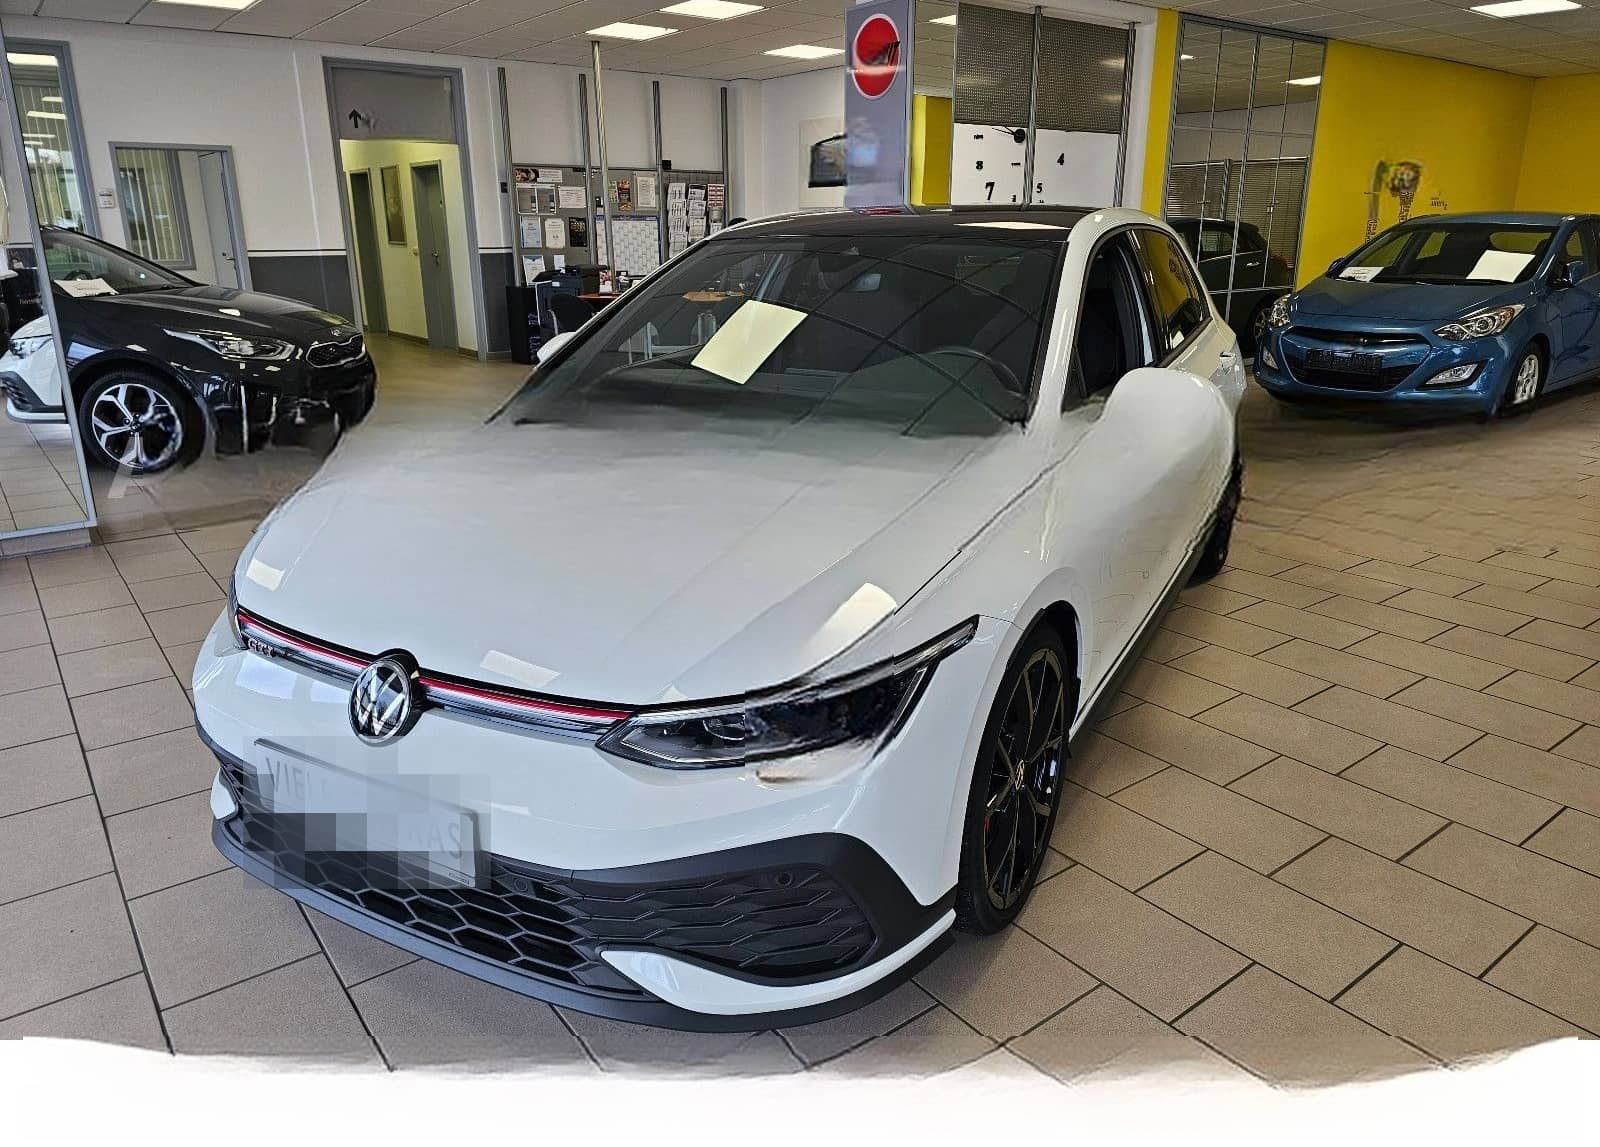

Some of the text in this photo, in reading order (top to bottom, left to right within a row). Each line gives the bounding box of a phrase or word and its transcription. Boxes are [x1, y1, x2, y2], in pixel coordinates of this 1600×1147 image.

[1056, 153, 1065, 165] 4
[985, 182, 995, 200] 7
[1036, 182, 1043, 193] 5
